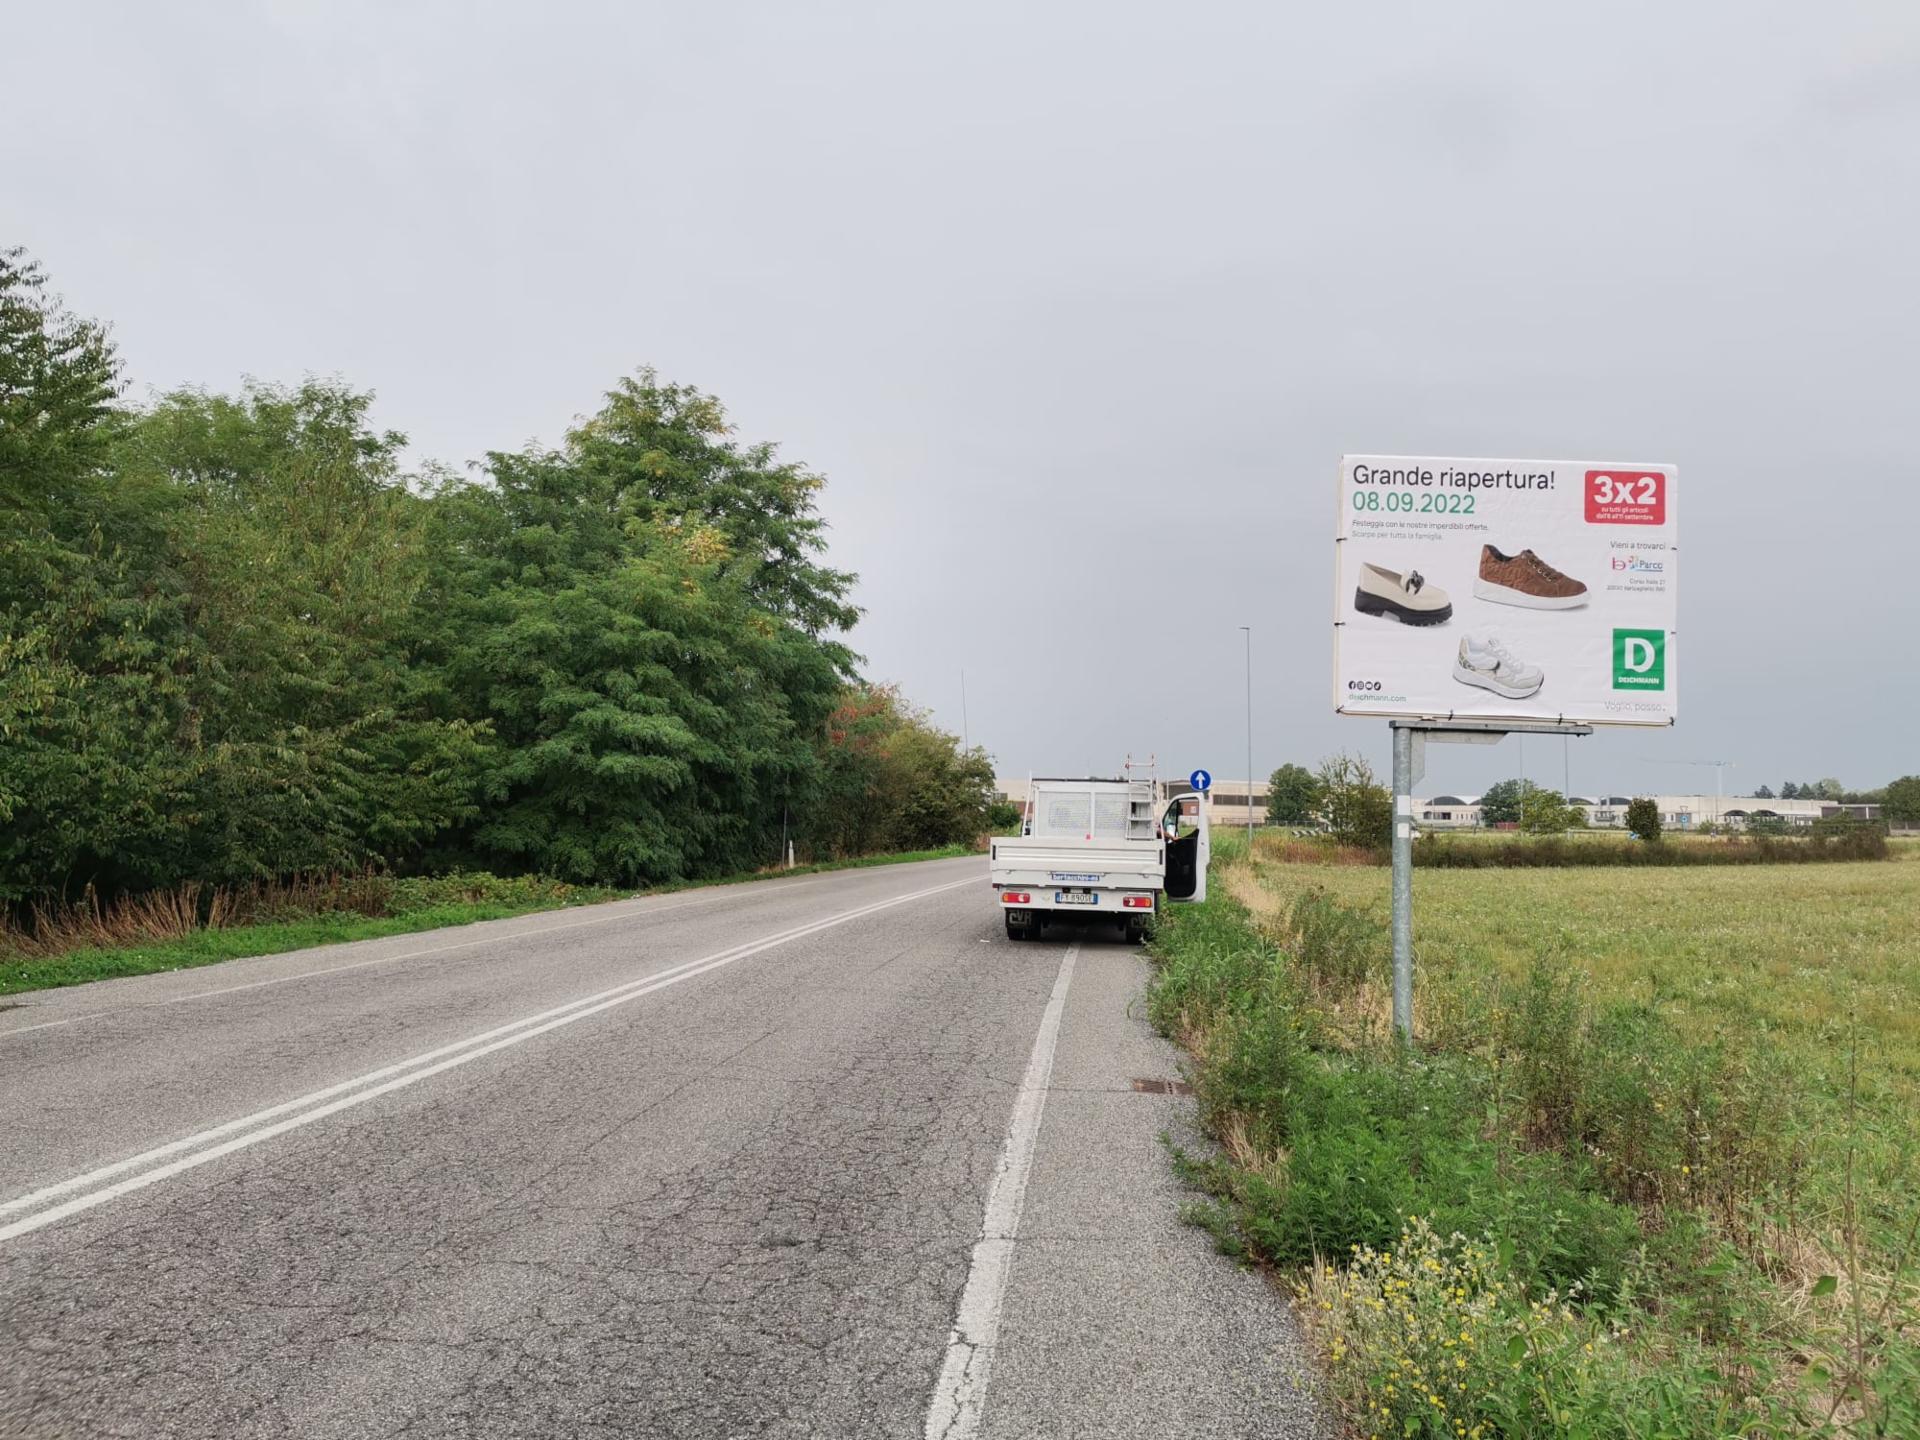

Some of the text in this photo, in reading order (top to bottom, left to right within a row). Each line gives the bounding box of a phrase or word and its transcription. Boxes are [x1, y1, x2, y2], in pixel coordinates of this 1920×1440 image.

[1353, 465, 1555, 492] Grande riapertura!
[1593, 475, 1656, 505] 3x2
[1352, 491, 1475, 514] 08.09.2022
[1352, 519, 1384, 529] Festeggia
[1429, 522, 1464, 530] imperdibili
[1610, 541, 1628, 549] Vieni
[1636, 542, 1666, 550] trovarci
[1640, 560, 1663, 570] Parco
[1625, 637, 1656, 673] D
[1618, 676, 1660, 684] DEICHMANN
[1348, 693, 1407, 703] deichmann.com
[1635, 703, 1666, 713] posso.
